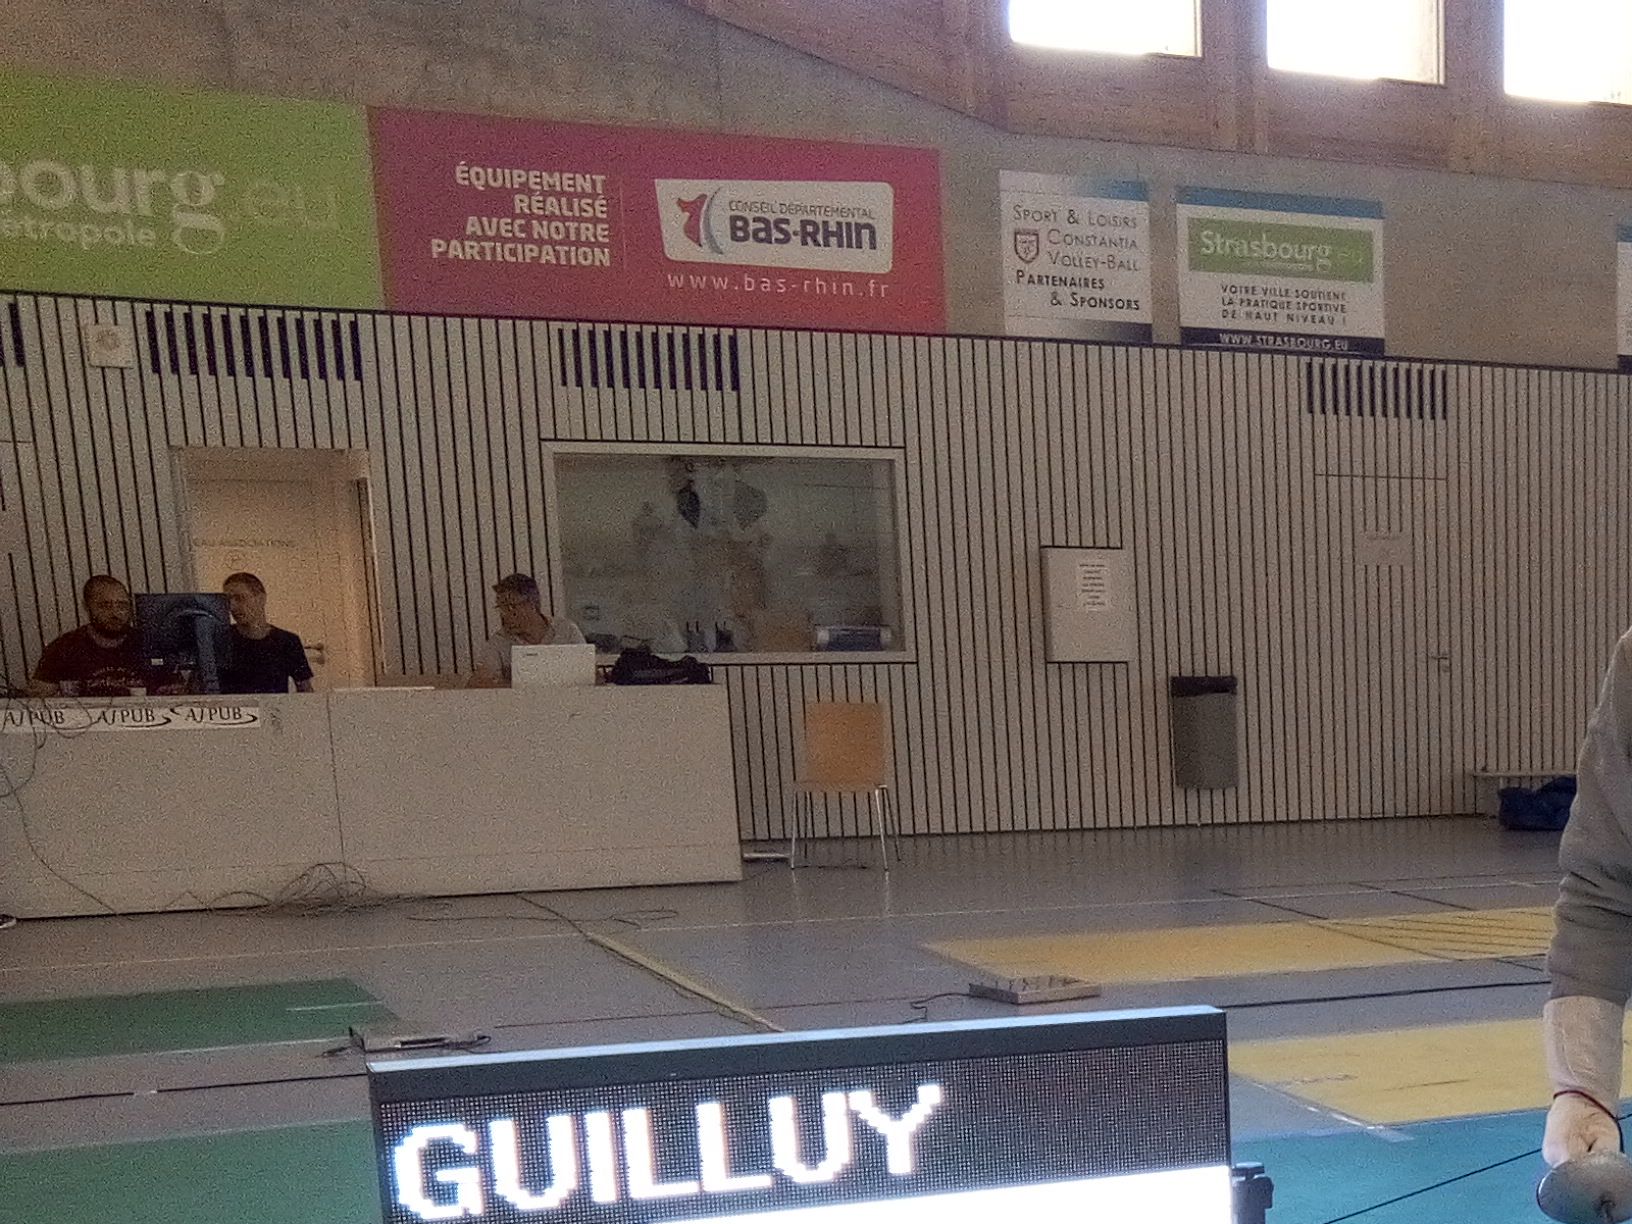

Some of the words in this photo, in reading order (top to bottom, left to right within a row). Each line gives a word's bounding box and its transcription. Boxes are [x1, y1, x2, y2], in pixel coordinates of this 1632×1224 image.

[455, 161, 607, 194] ÉQUIPEMENT
[513, 191, 608, 219] RÉALISÉ
[1067, 209, 1079, 225] &
[465, 216, 526, 238] AVEC
[531, 220, 610, 243] NOTRE
[431, 238, 611, 267] PARTICIPATION
[1200, 229, 1333, 274] Strasbourg
[667, 273, 890, 298] www.bas-rhin.fr
[1050, 291, 1062, 306] &
[1222, 296, 1235, 307] LA
[1239, 298, 1292, 311] PRATIQUE
[1222, 309, 1237, 320] DE
[1286, 313, 1336, 326] NIVEAU
[394, 1083, 943, 1222] GUILLUY
